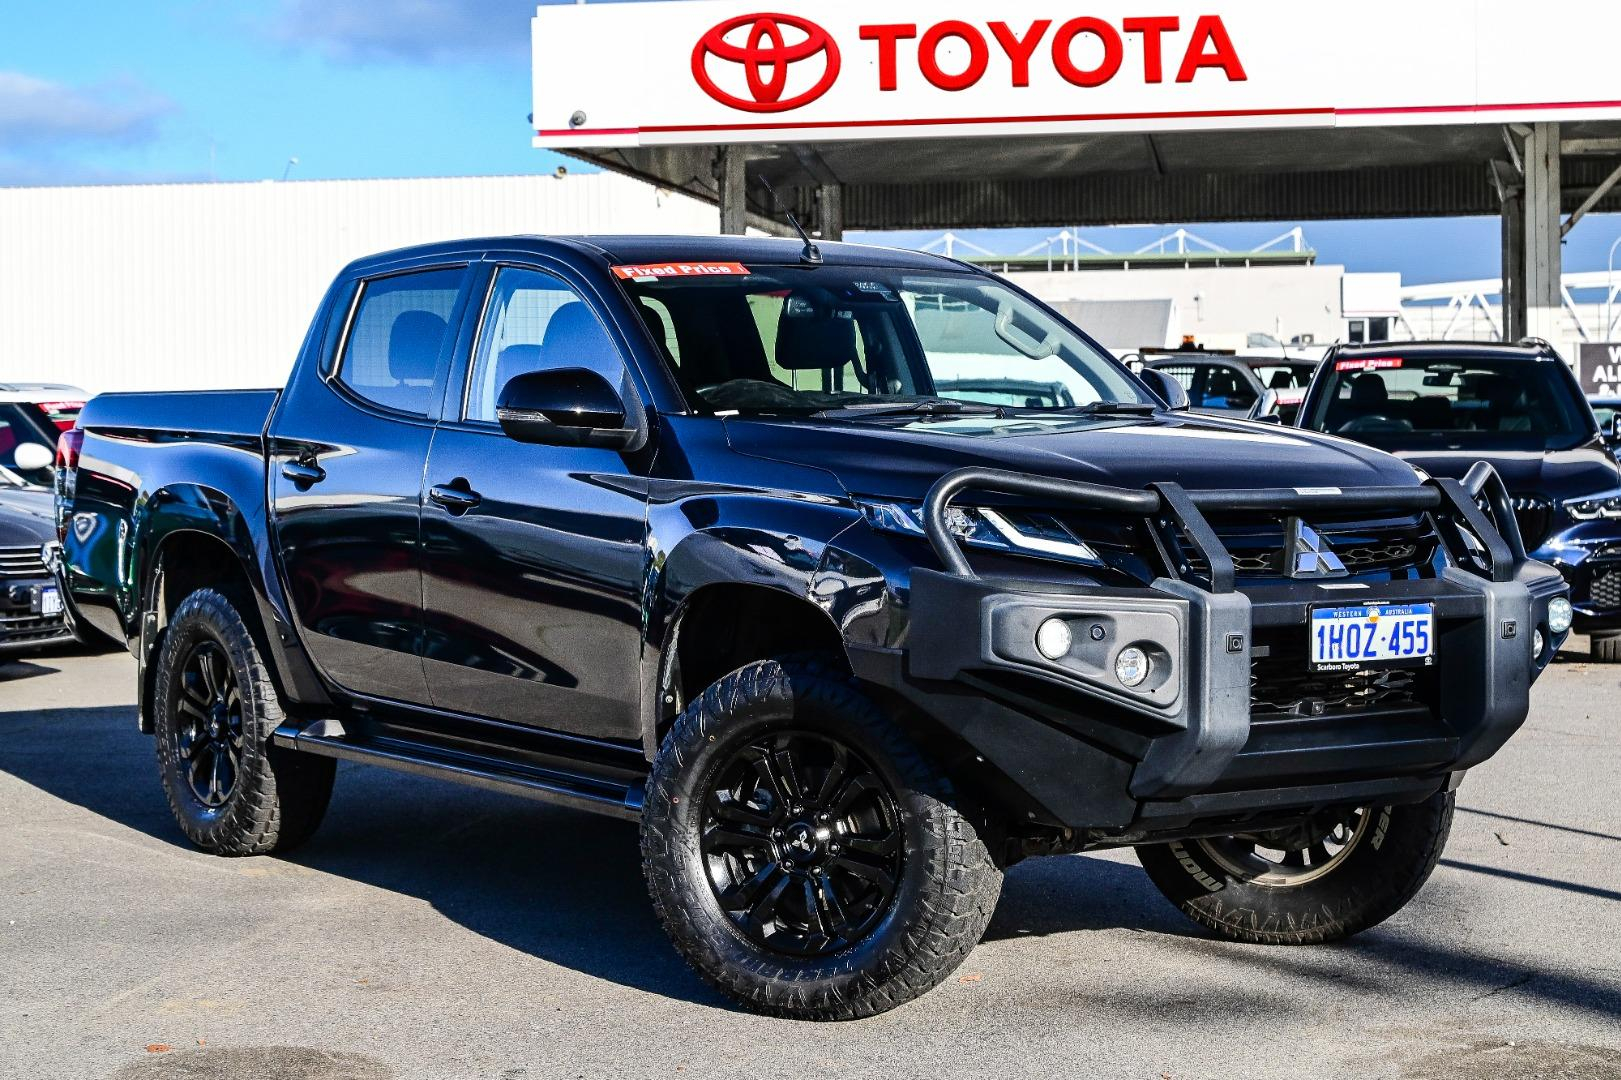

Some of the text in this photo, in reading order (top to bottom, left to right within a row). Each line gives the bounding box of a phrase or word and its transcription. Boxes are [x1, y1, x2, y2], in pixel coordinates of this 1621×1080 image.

[859, 15, 1248, 91] TOYOTA
[622, 264, 732, 278] Fixed Price
[1592, 364, 1621, 383] AL
[1332, 608, 1413, 618] WESTERN AUSTRALIA
[1317, 662, 1360, 672] Scarboro Toyota
